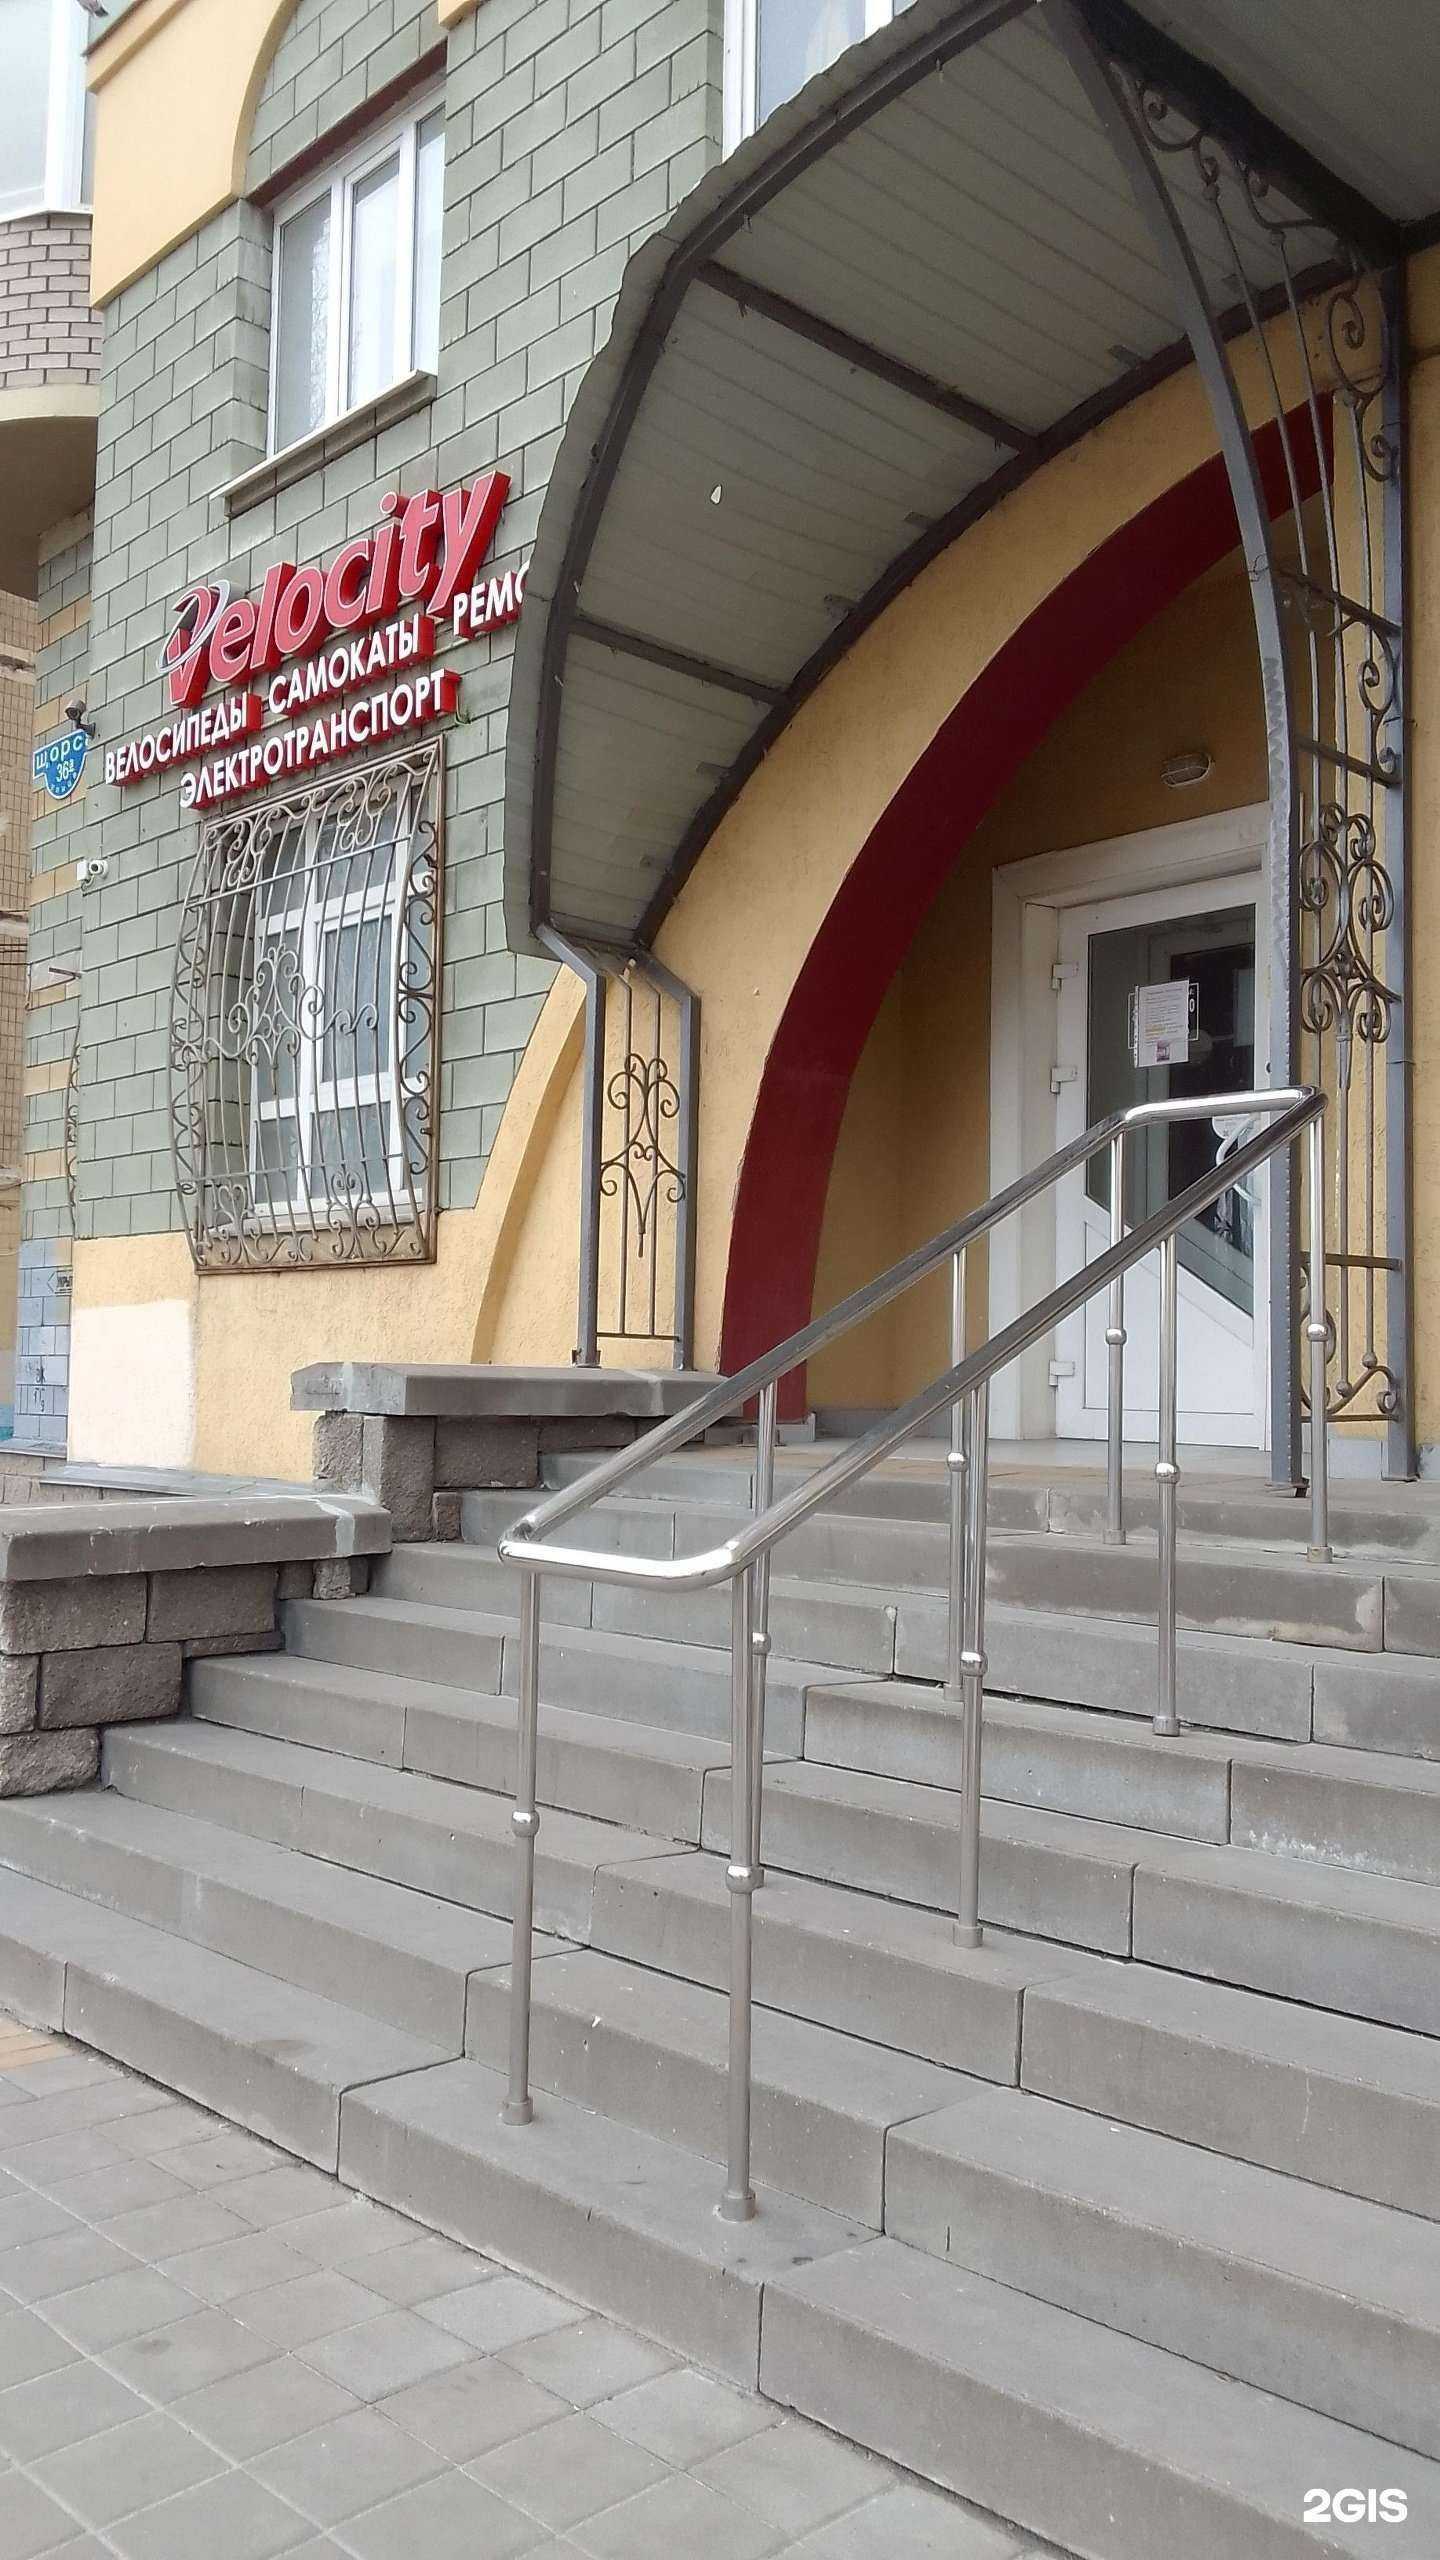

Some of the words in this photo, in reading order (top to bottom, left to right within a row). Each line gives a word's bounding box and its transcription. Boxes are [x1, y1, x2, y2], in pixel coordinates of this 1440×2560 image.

[158, 471, 511, 706] Velocity
[105, 691, 248, 785] ВЕЛОСИПЕДЫ
[268, 614, 419, 714] САМОКАТЫ
[180, 669, 446, 810] ЭЛЕКТРОТРАНСПОРТ
